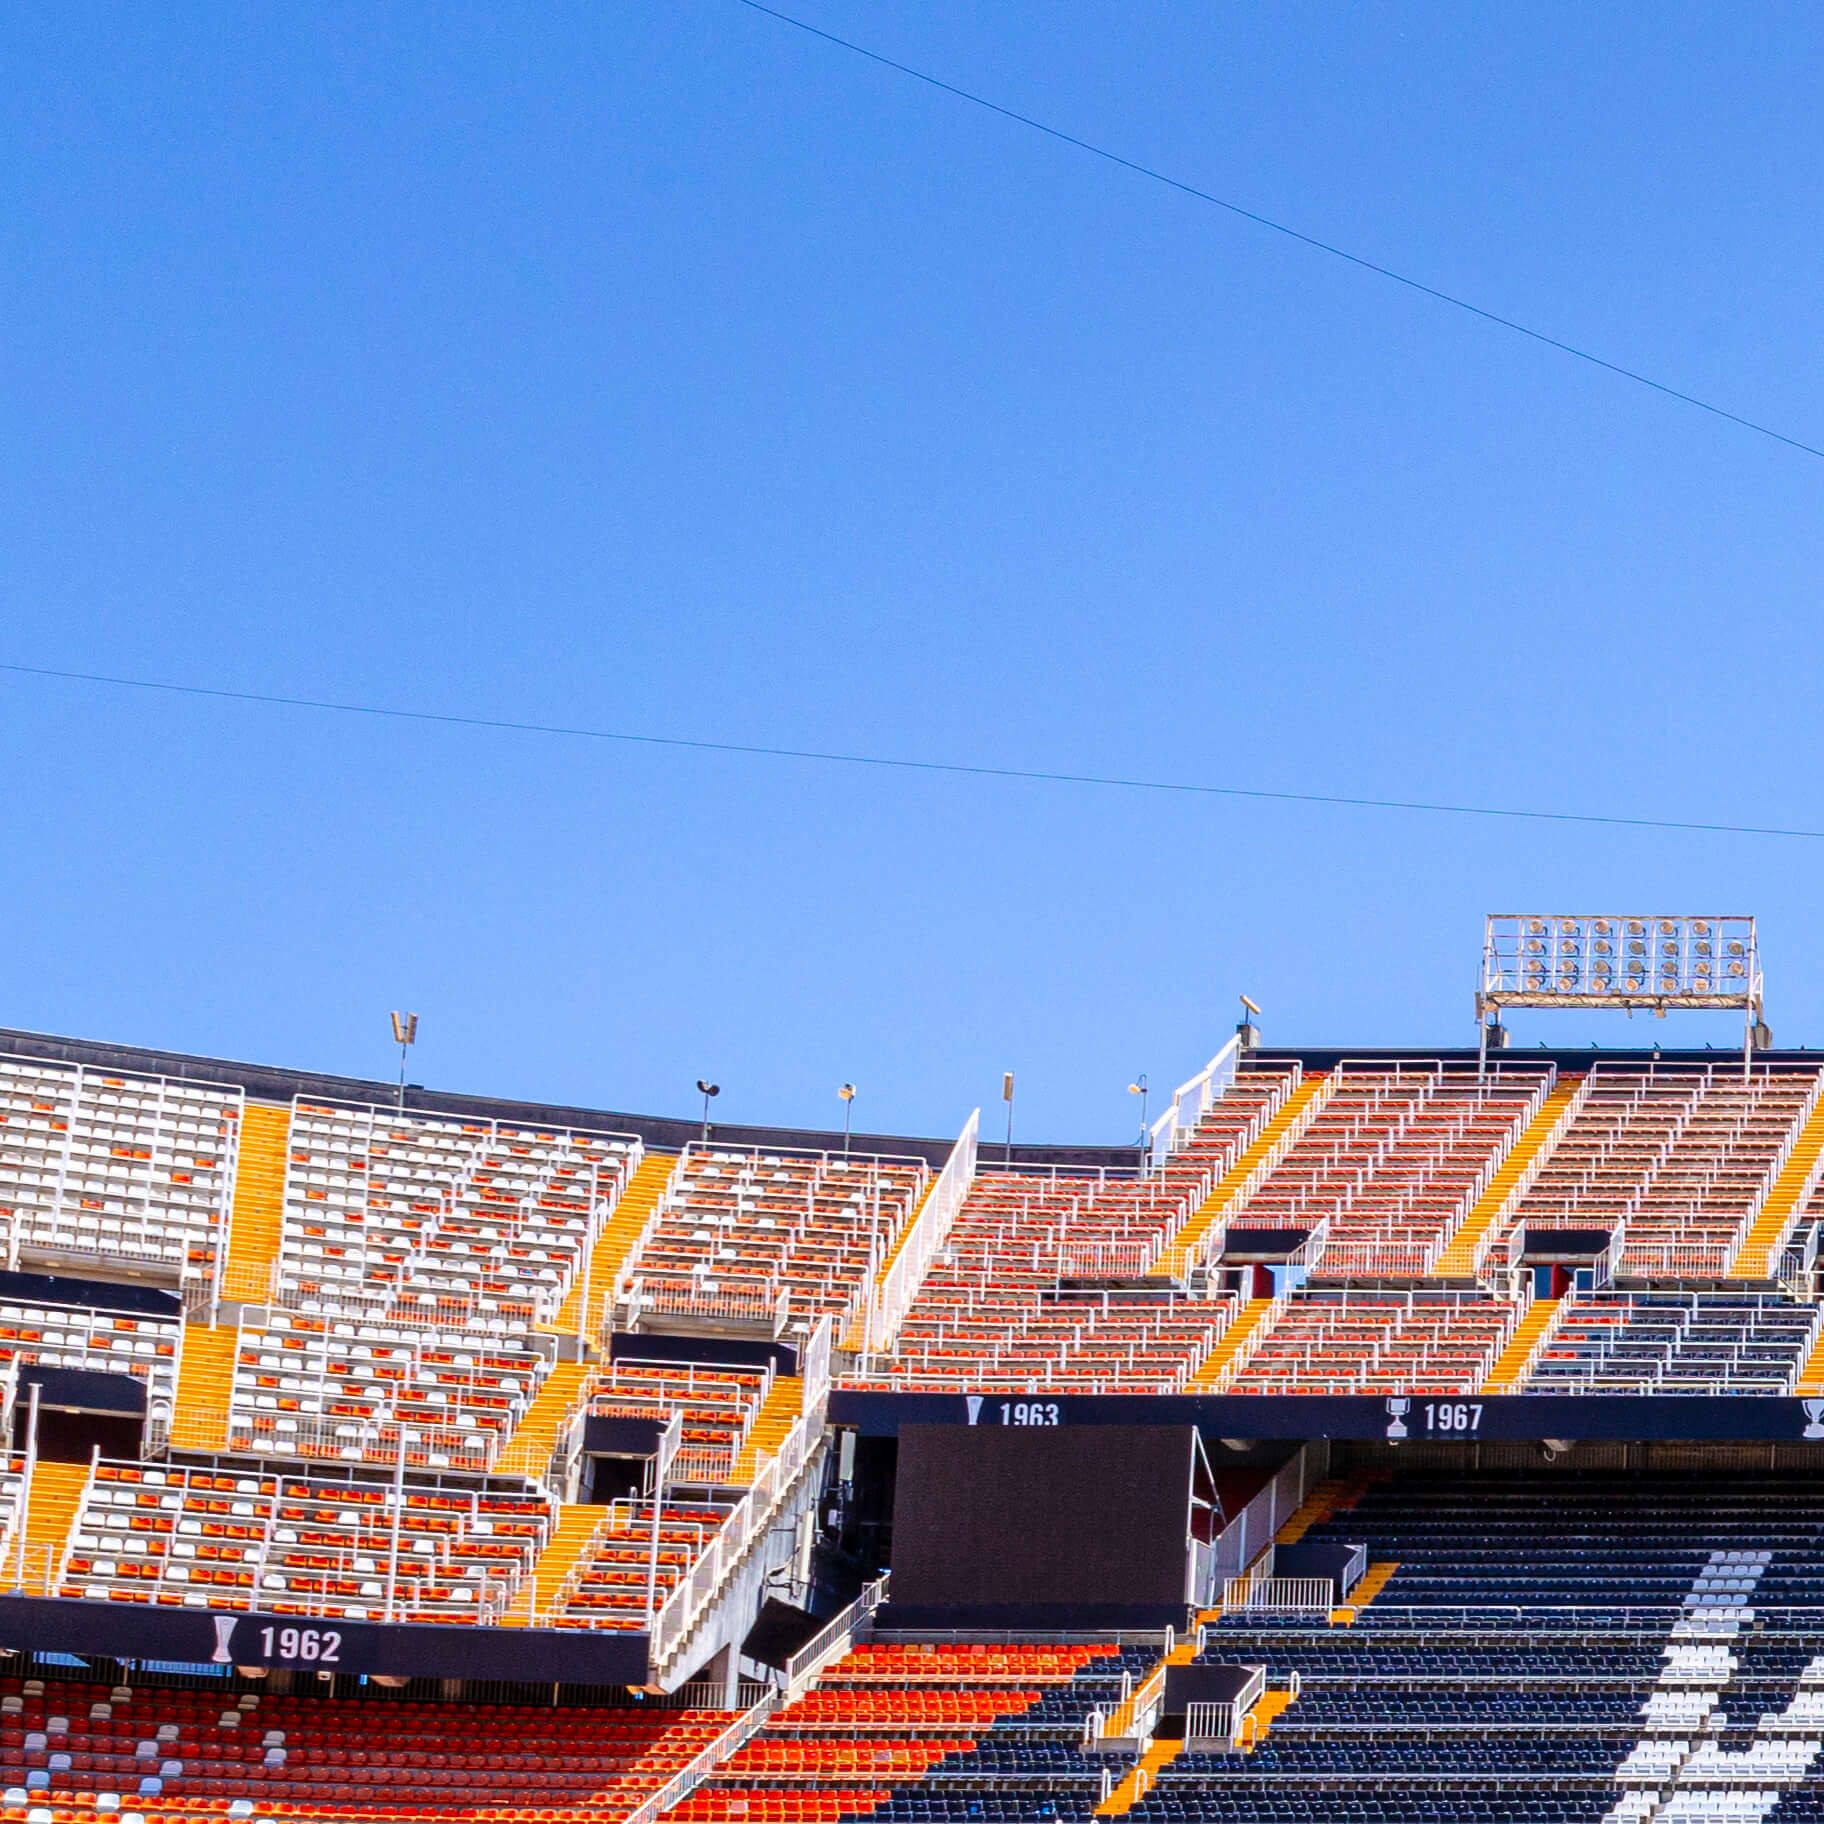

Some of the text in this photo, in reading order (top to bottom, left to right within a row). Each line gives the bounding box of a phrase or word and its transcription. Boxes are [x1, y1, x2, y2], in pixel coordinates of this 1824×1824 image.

[1000, 1403, 1060, 1426] 1963
[1424, 1403, 1484, 1431] 1967
[261, 1626, 341, 1662] 1962
